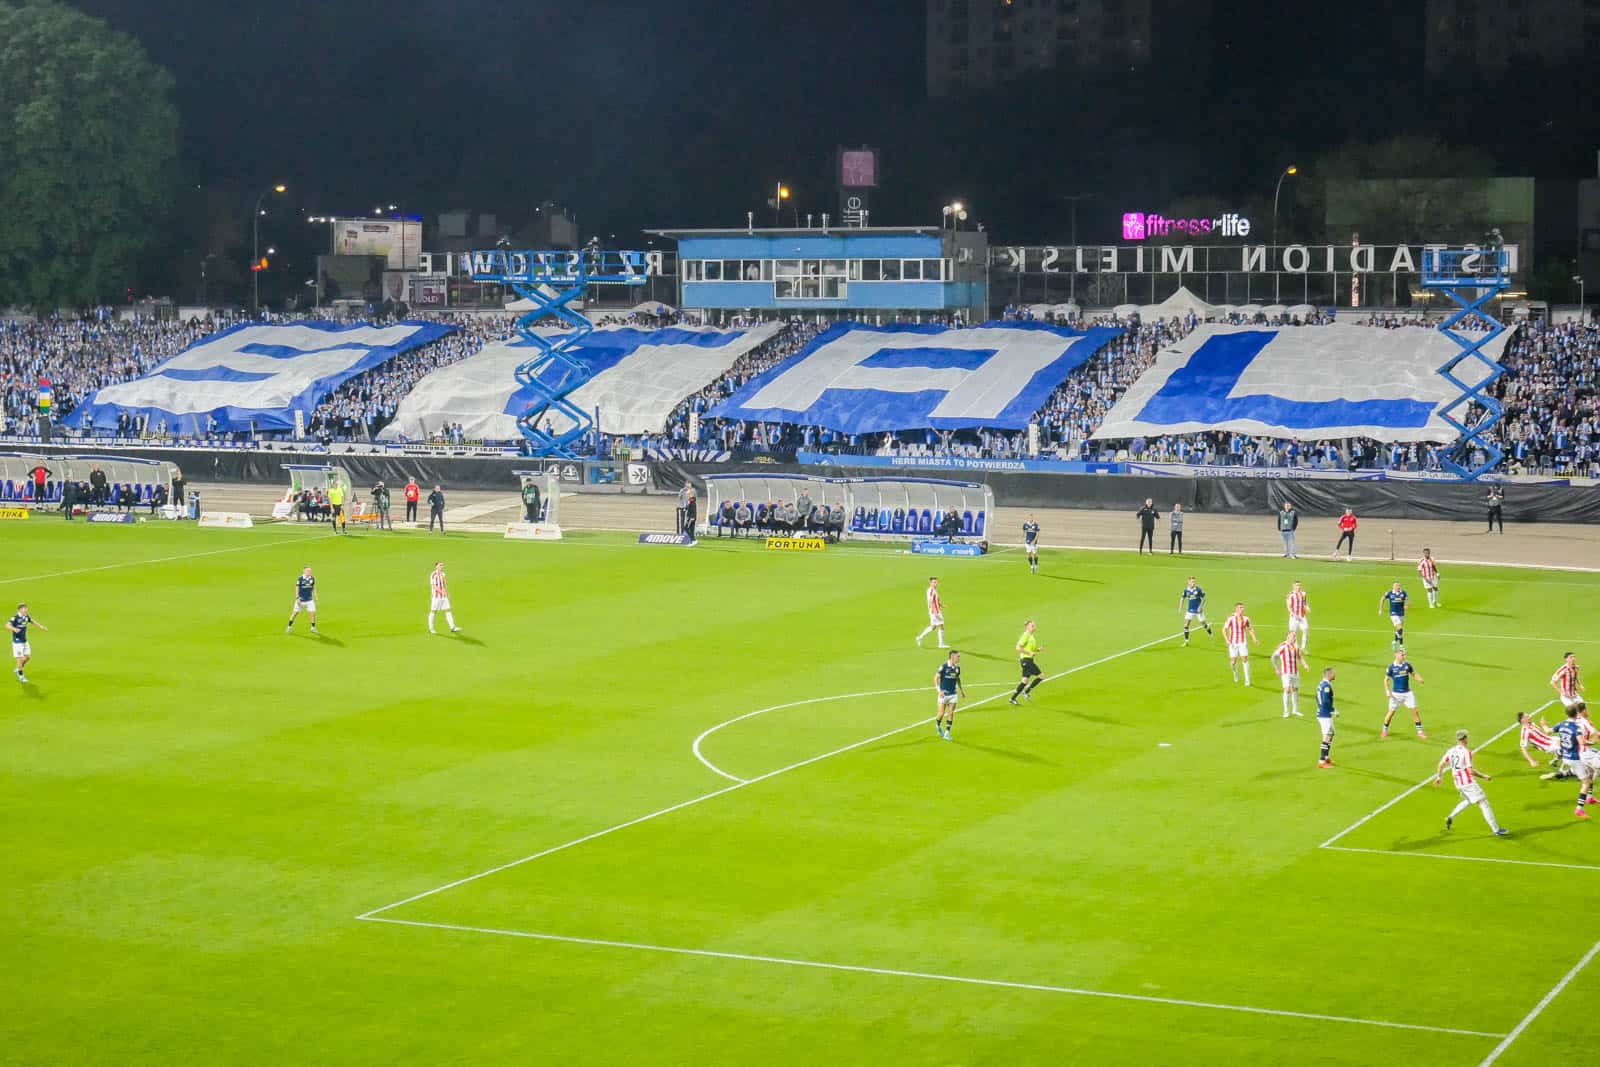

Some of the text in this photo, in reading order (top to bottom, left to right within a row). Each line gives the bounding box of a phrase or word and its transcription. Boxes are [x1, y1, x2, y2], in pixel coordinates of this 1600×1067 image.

[1145, 214, 1211, 236] fitness
[1222, 213, 1251, 237] life
[918, 457, 952, 467] MIASTA
[953, 459, 965, 468] TO
[966, 460, 1026, 471] POTWIERDZA
[645, 533, 685, 545] 4MOVE
[766, 539, 822, 550] FORTUNA
